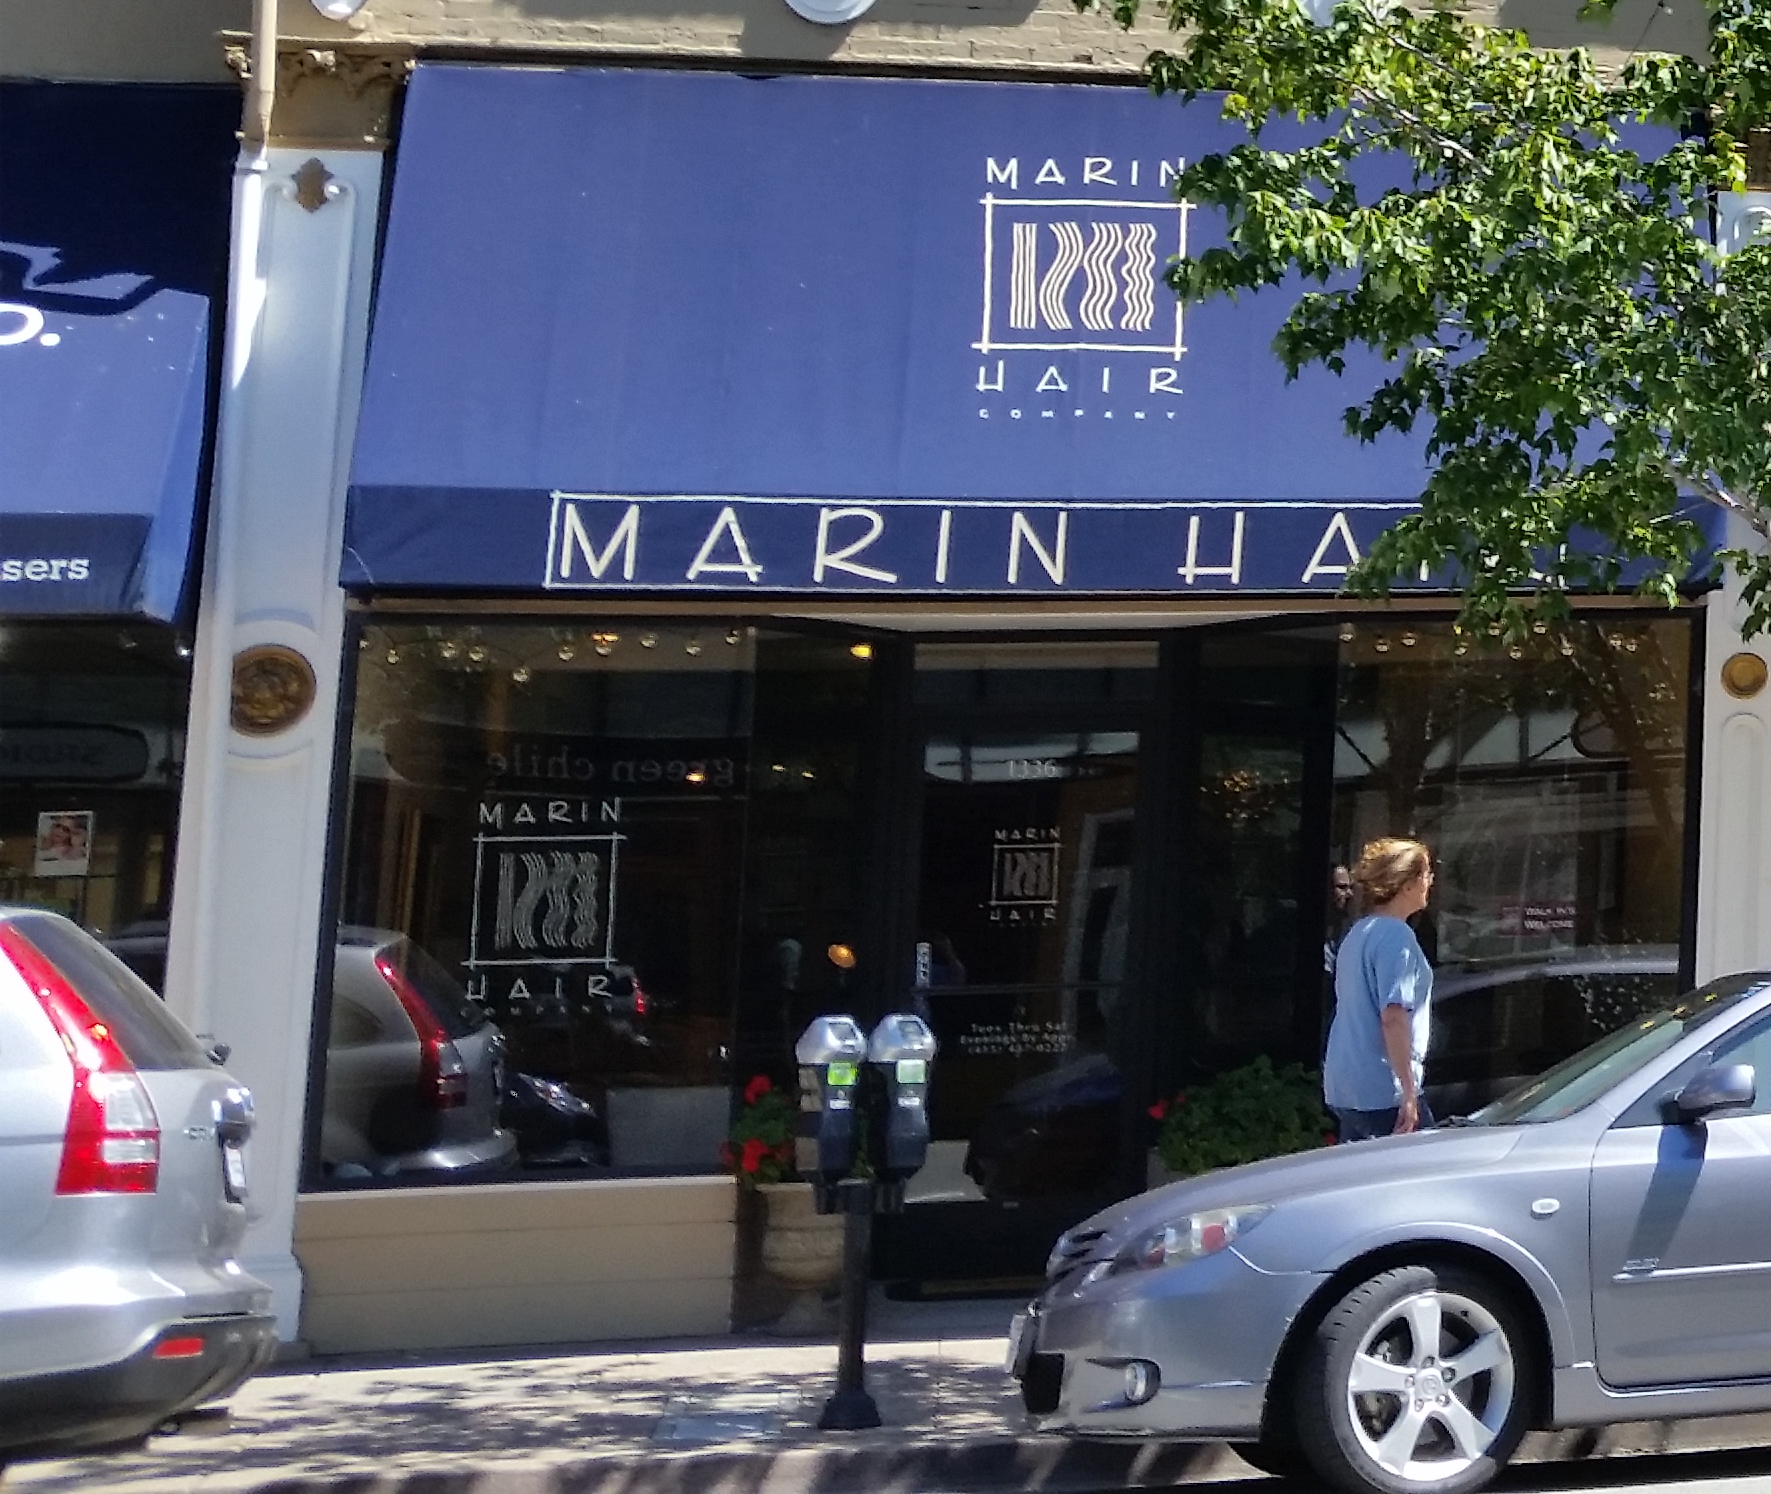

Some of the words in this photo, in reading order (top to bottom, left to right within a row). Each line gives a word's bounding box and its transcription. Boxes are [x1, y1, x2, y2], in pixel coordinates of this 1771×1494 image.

[987, 157, 1187, 190] MARIN
[975, 360, 1184, 395] HAIR
[979, 408, 1175, 421] COMPANY
[561, 503, 1068, 585] MARIN
[479, 796, 621, 829] MARIN
[466, 973, 613, 1001] HAIR
